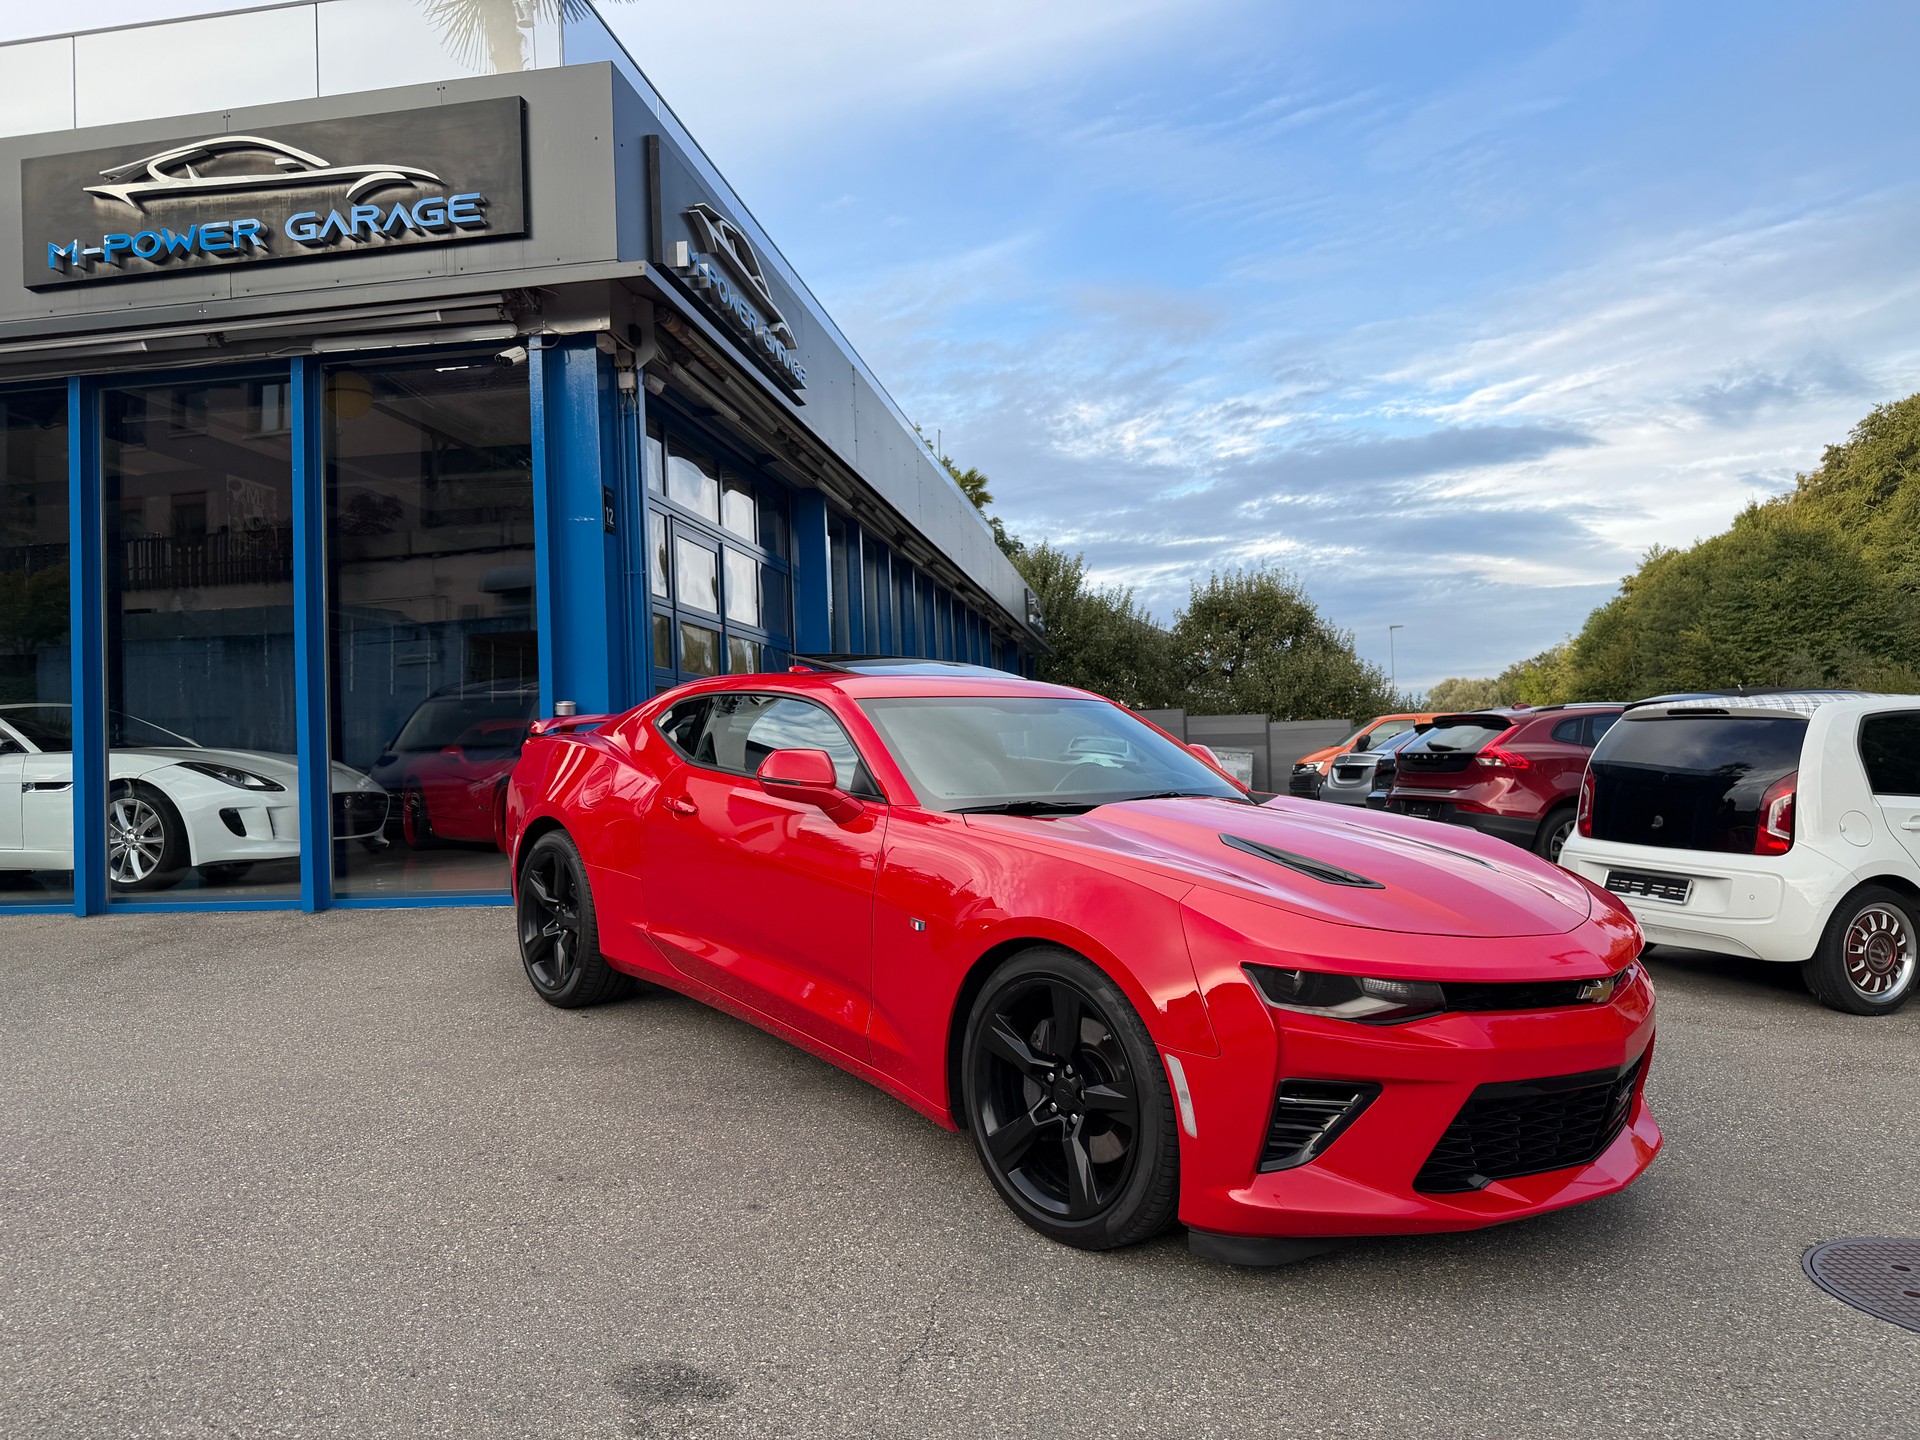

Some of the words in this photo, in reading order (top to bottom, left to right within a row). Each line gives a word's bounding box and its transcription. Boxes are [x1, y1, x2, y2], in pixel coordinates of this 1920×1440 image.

[47, 218, 264, 270] M-POWER
[284, 192, 482, 242] GARAGE
[676, 240, 758, 337] M-POWER
[763, 325, 808, 390] GARAGE
[605, 506, 615, 526] 12
